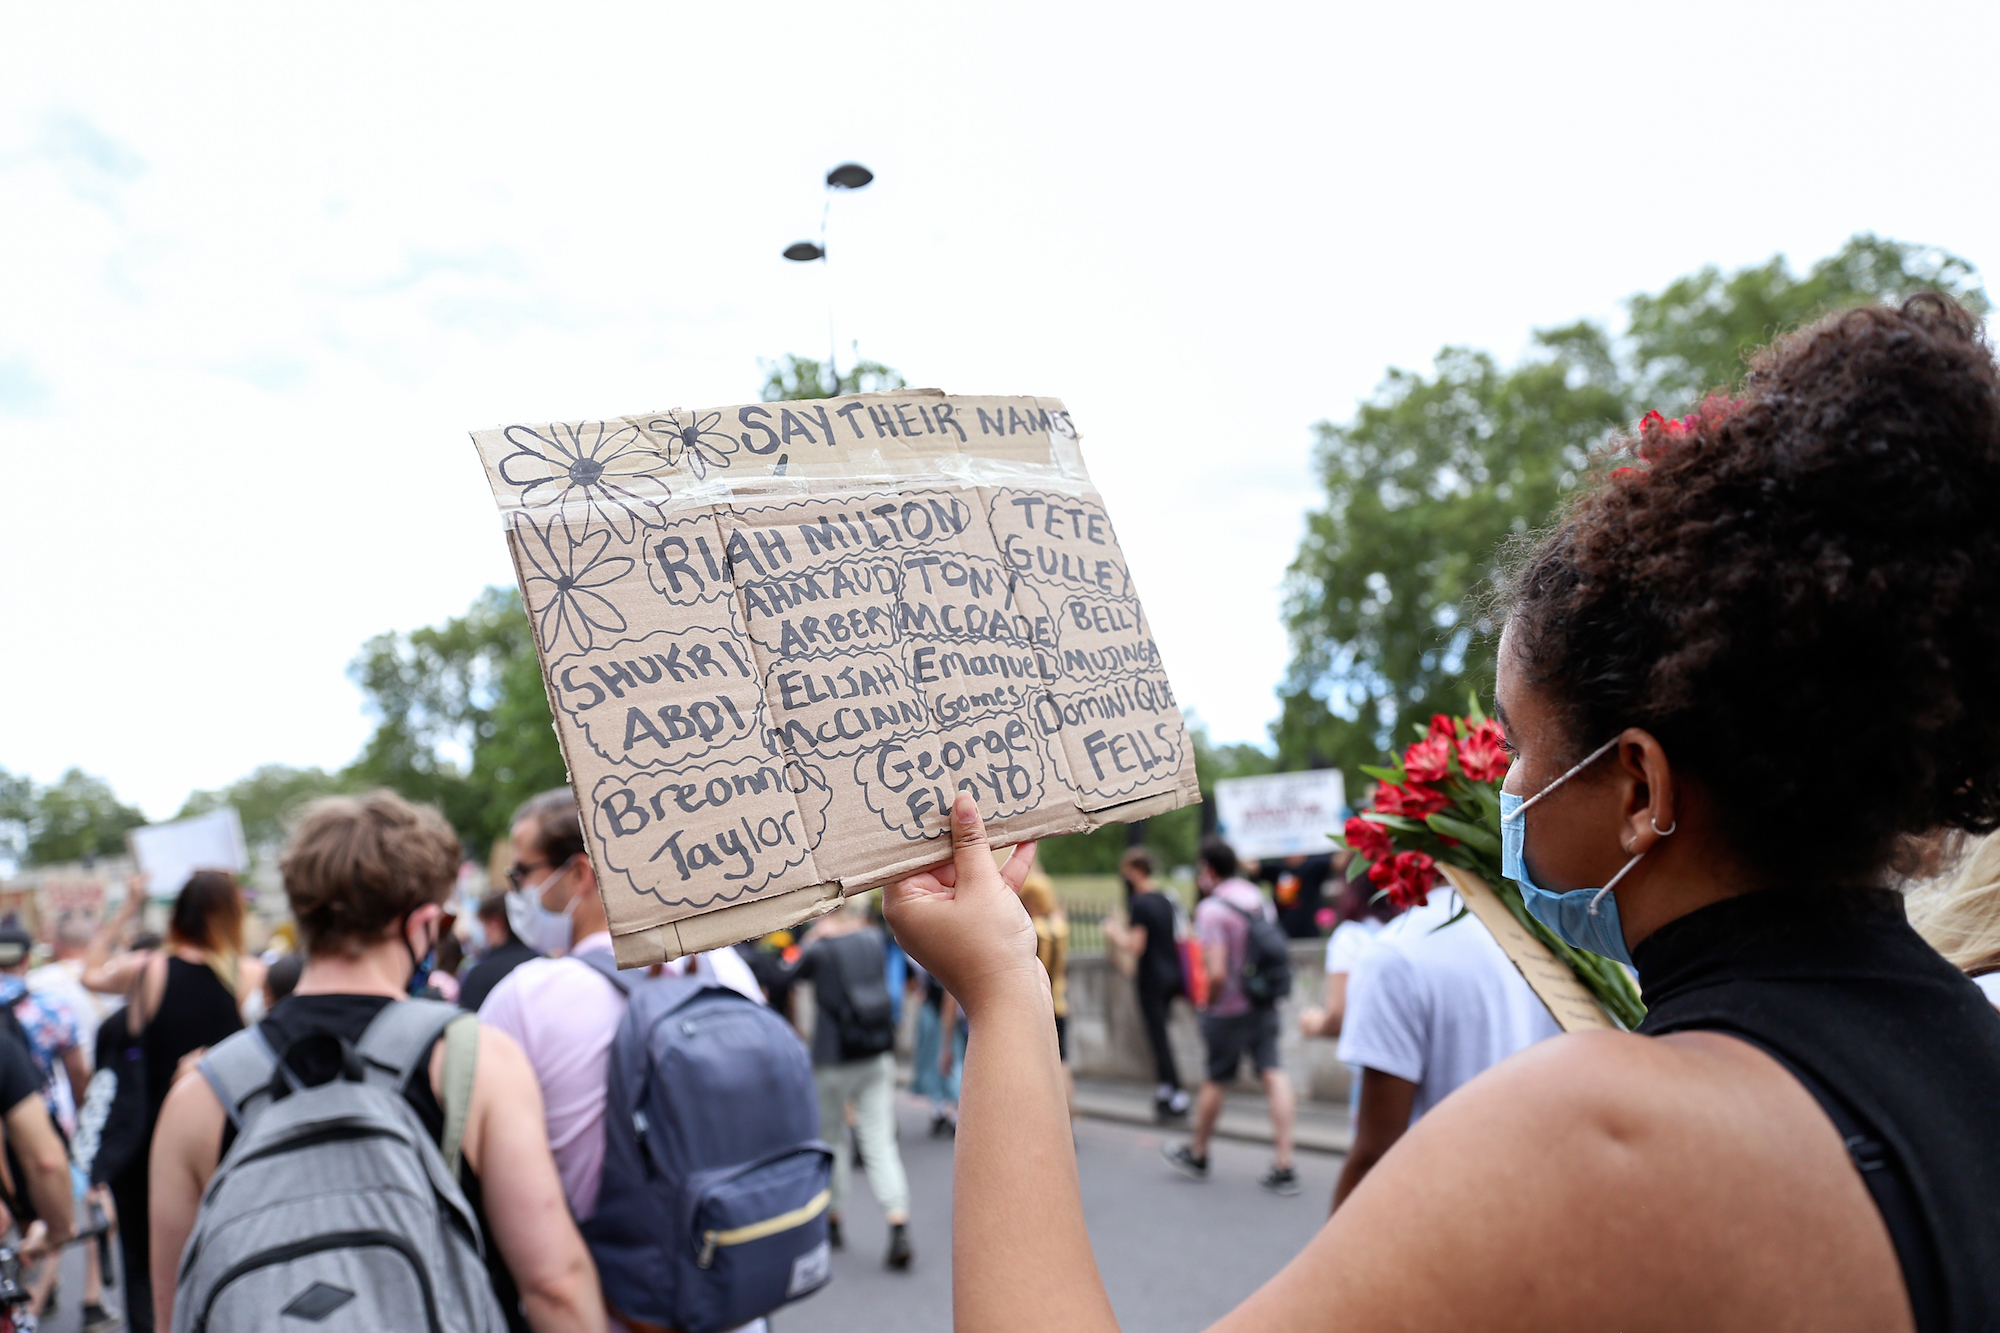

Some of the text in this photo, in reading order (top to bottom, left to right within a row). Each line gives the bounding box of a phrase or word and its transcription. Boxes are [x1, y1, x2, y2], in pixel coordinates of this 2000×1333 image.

[738, 401, 1077, 455] SAY THEIR NAMES
[653, 499, 963, 593] RIAH MILTON
[1011, 497, 1106, 545] TETE
[744, 562, 899, 621] AHMAUD
[903, 556, 1018, 611] TONY
[1005, 534, 1131, 599] GULLEY
[780, 603, 899, 655] ARBERY
[1069, 601, 1142, 635] BELLY
[561, 640, 751, 710] SHUKRI
[1064, 638, 1161, 676] MUJINGA
[777, 663, 900, 711] ELIJAH
[935, 684, 1021, 721] Gomes
[623, 695, 746, 751] ABDI
[876, 719, 1031, 793] George
[1083, 723, 1175, 781] FELLS
[601, 759, 826, 838] Breonna
[649, 809, 796, 881] Taylor
